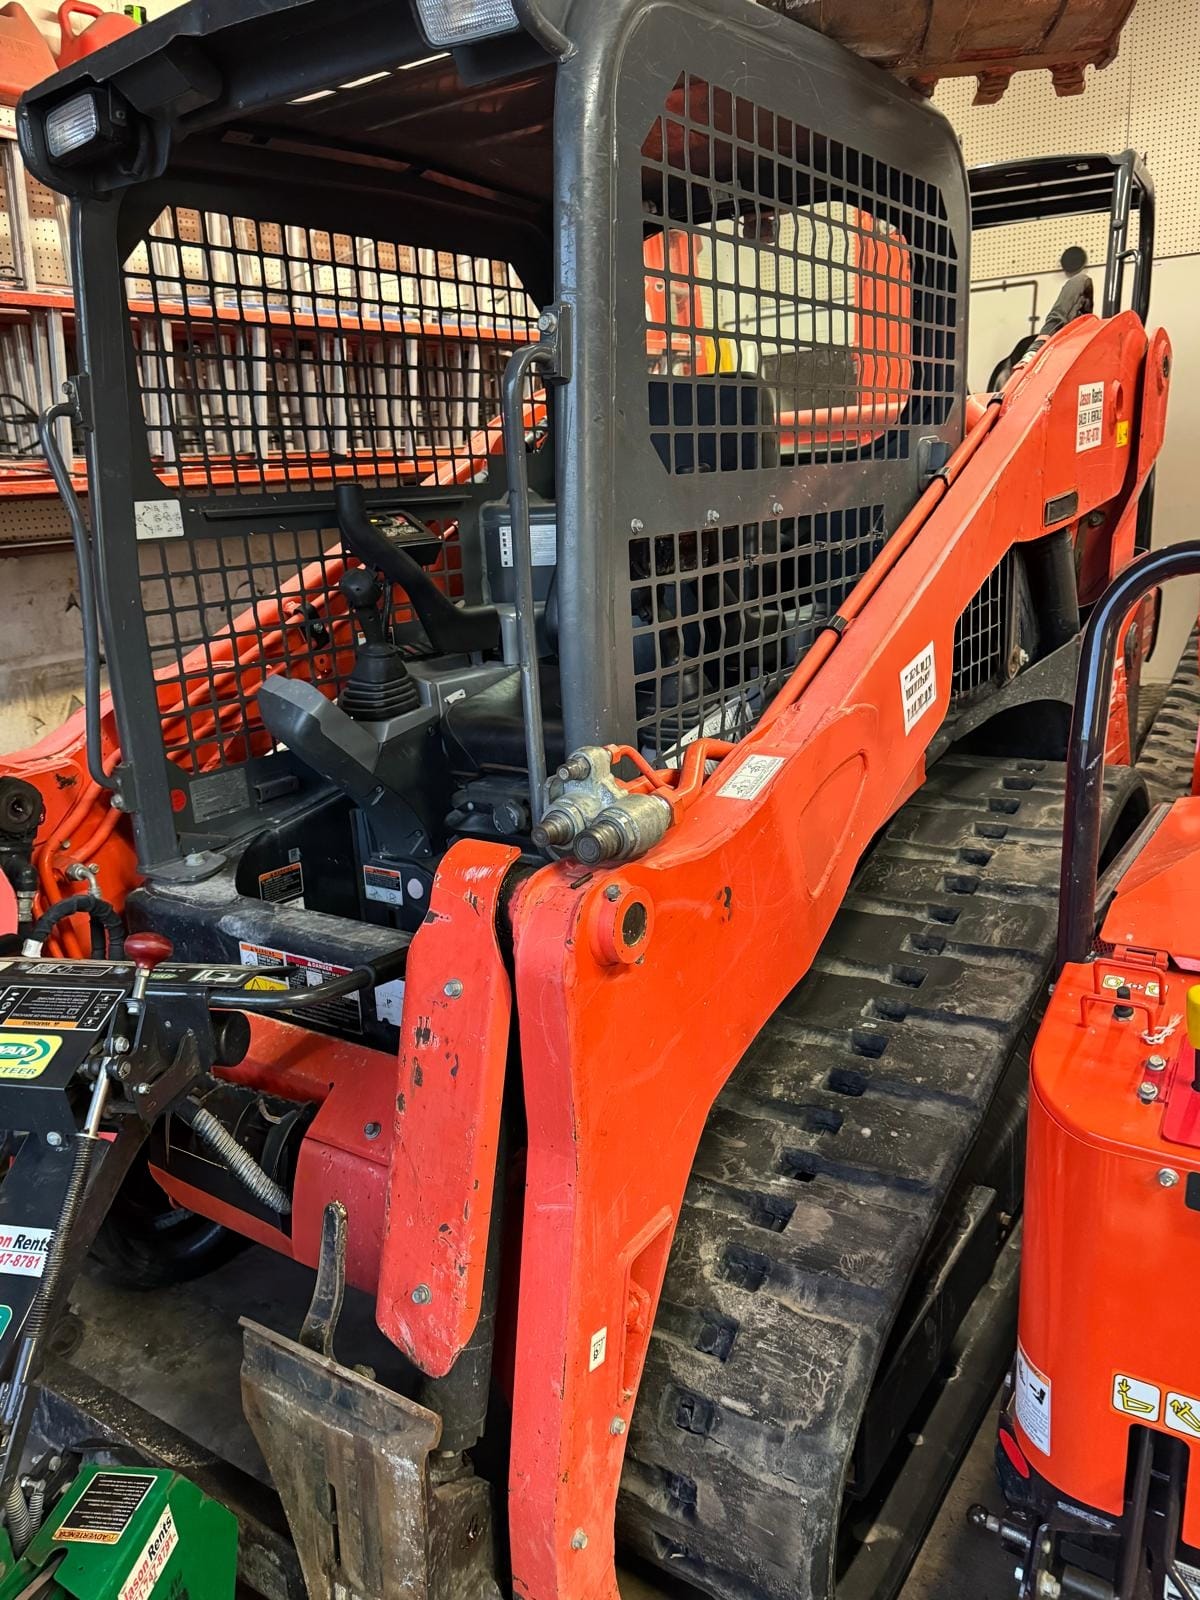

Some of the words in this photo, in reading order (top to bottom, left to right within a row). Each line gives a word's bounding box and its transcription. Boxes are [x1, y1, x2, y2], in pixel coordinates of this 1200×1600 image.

[312, 962, 333, 972] DANGER
[0, 1066, 37, 1075] TEER
[147, 1516, 173, 1562] Rents
